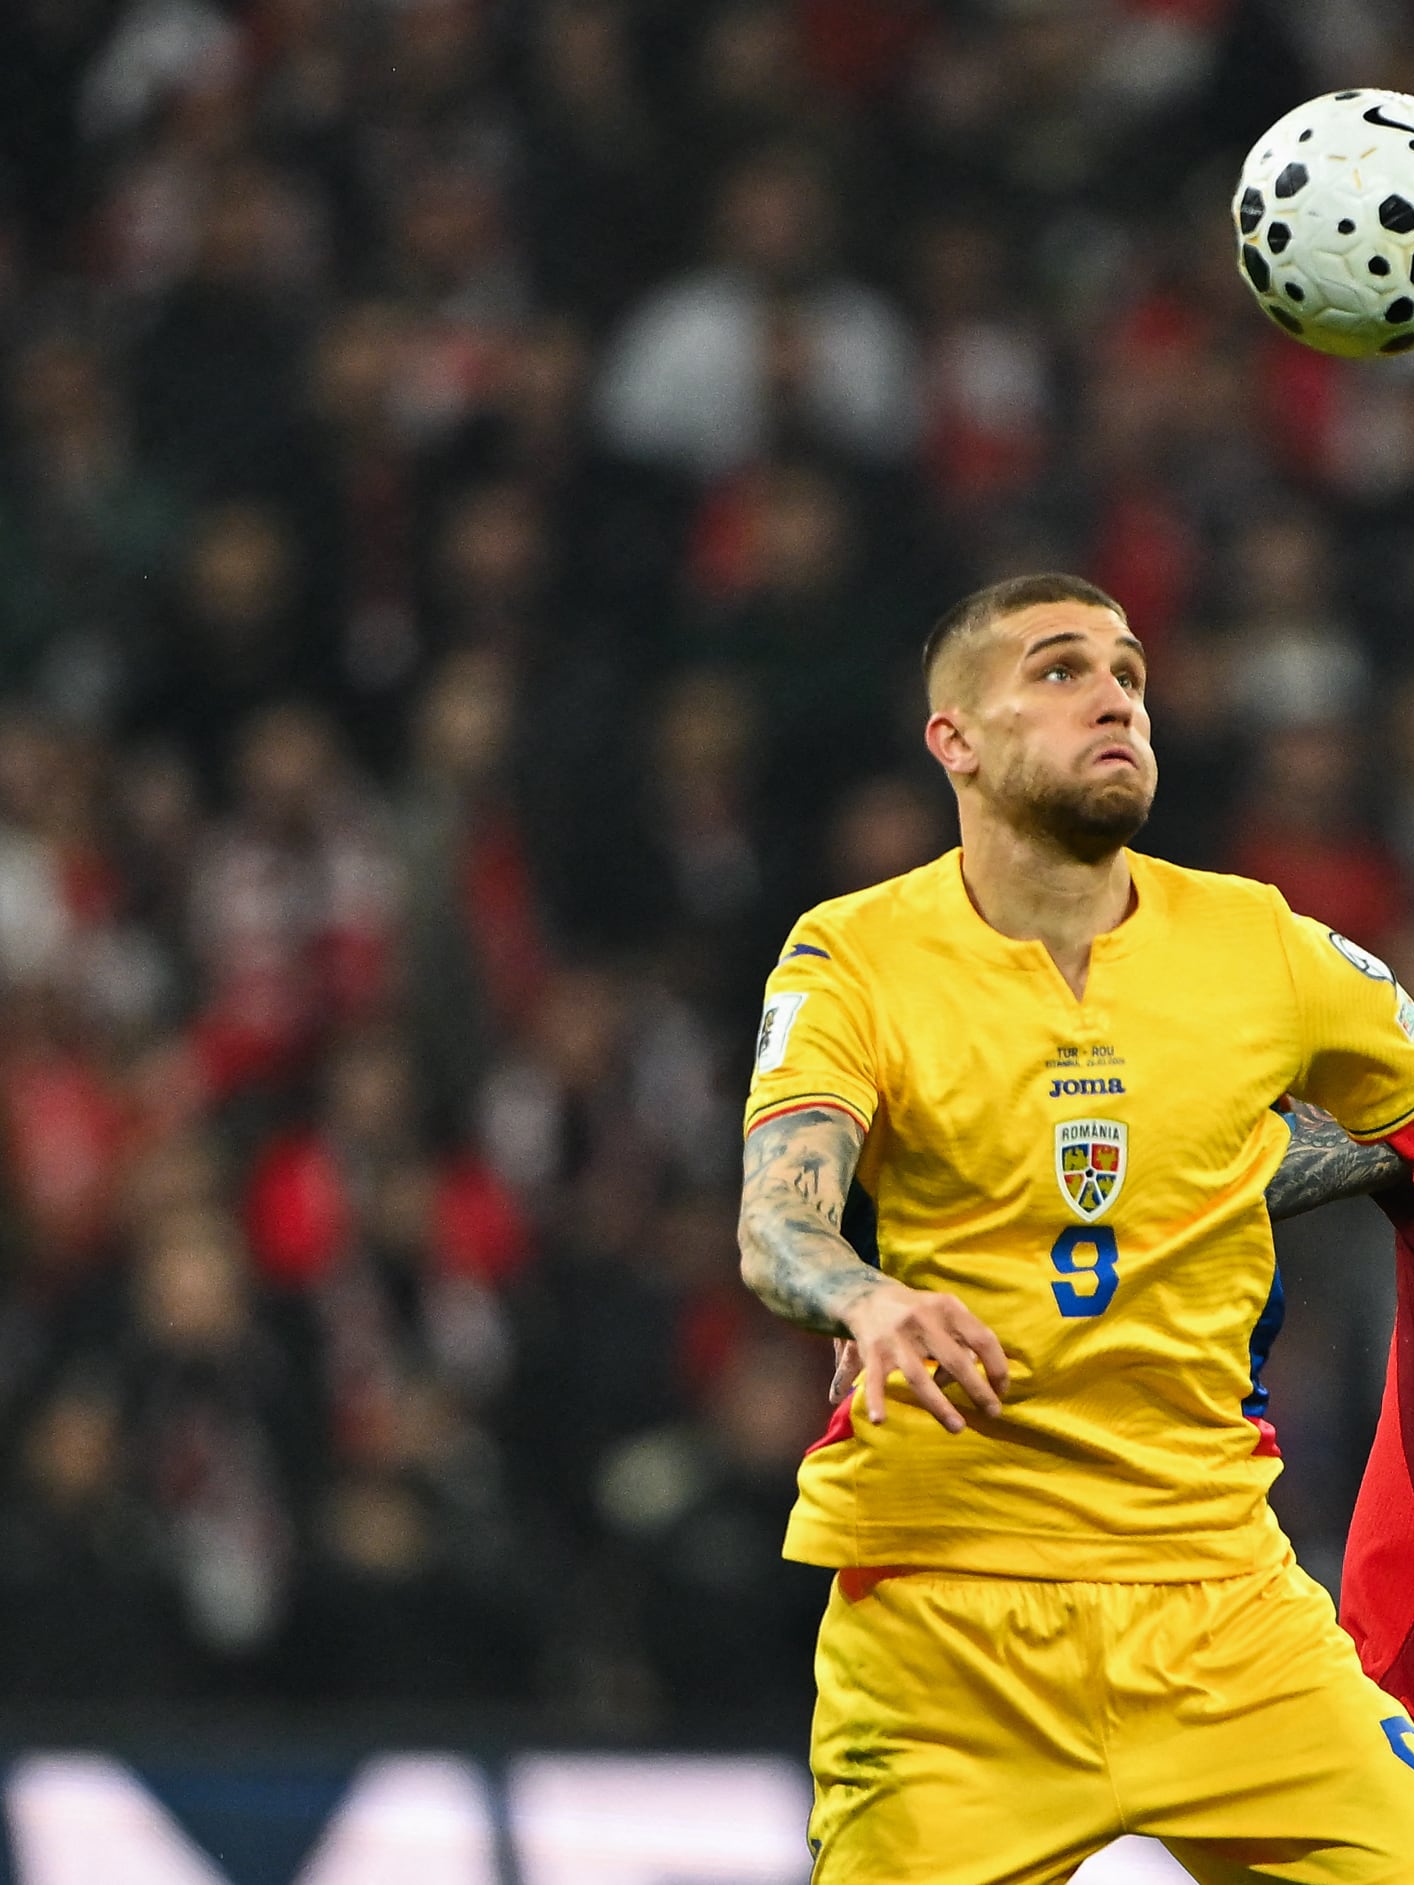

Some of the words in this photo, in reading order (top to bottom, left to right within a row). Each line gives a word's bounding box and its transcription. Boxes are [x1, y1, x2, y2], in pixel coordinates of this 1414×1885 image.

[1057, 1047, 1078, 1057] TUR
[1092, 1045, 1114, 1056] ROU
[1062, 1120, 1120, 1141] ROMÂNIA
[1050, 1226, 1120, 1317] 9
